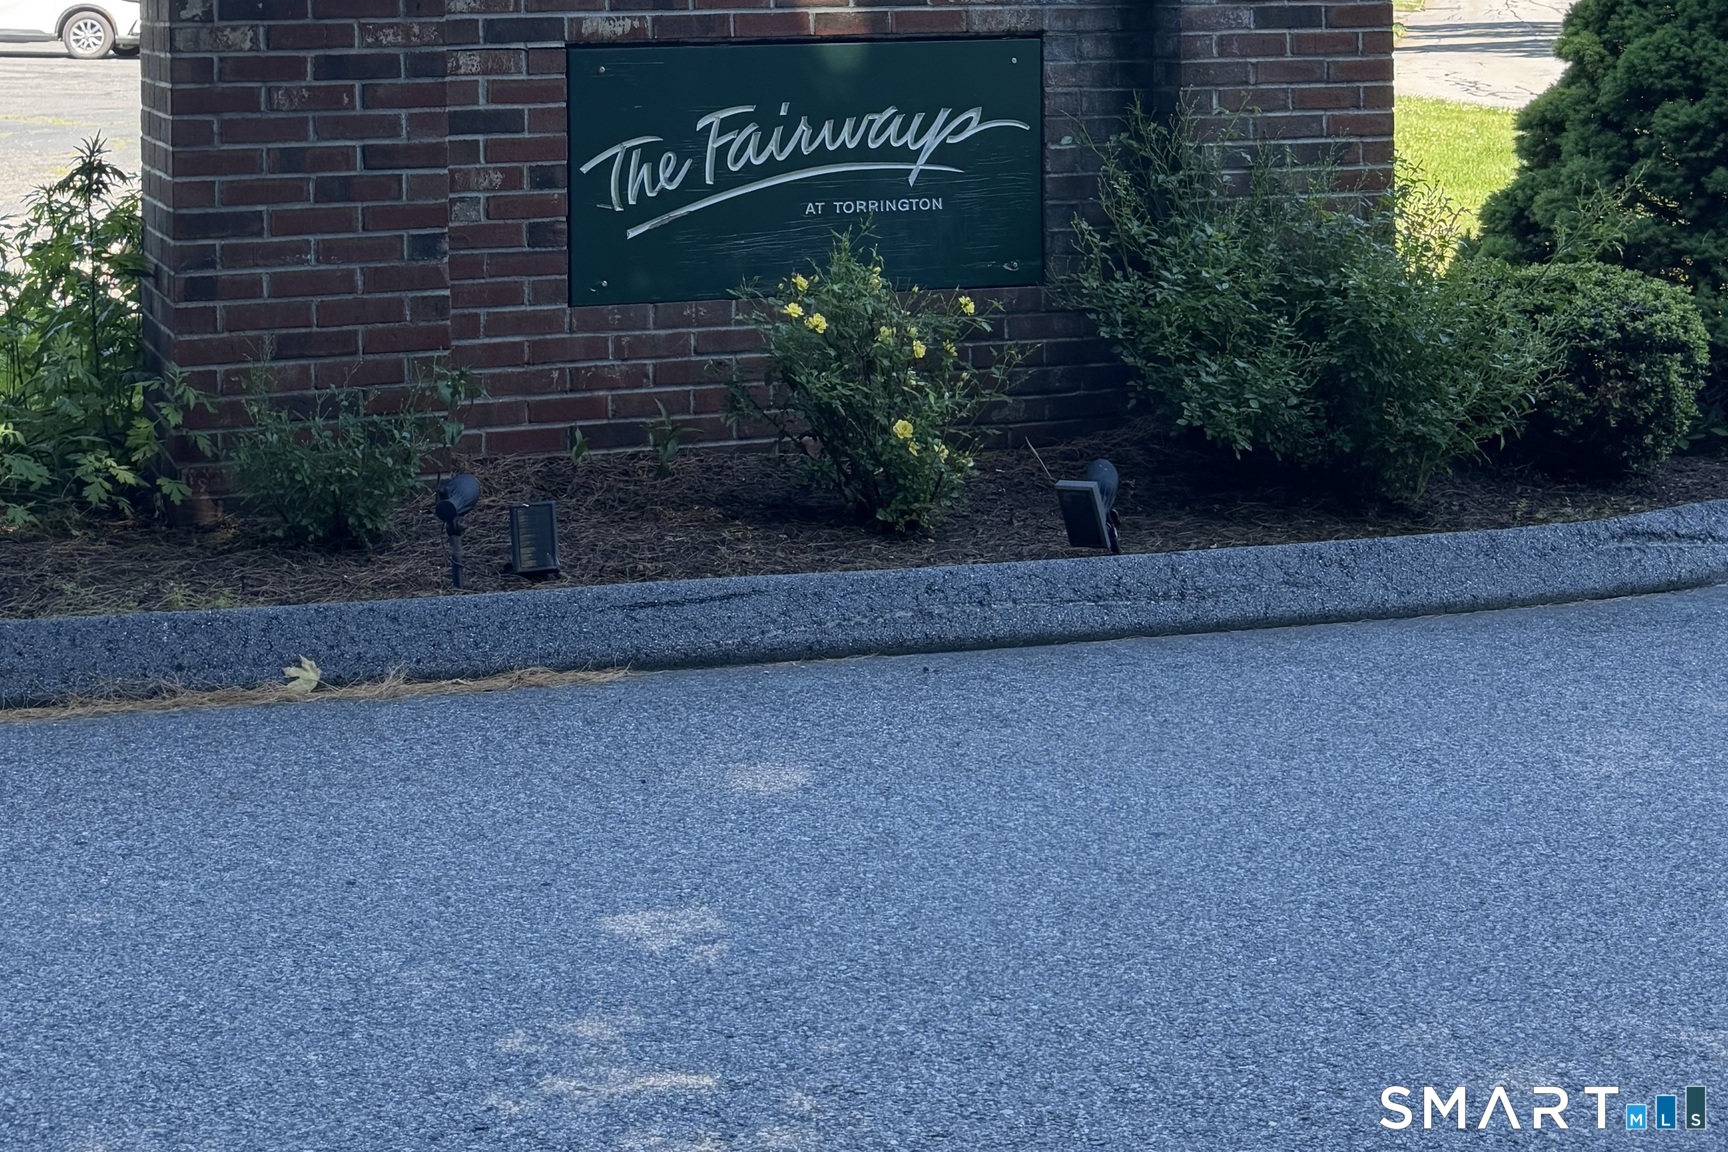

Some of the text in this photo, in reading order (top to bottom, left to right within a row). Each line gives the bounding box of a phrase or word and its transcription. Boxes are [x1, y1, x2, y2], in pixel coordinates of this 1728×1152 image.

[579, 101, 1030, 212] The Fairways
[805, 197, 944, 215] AT TORRINGTON
